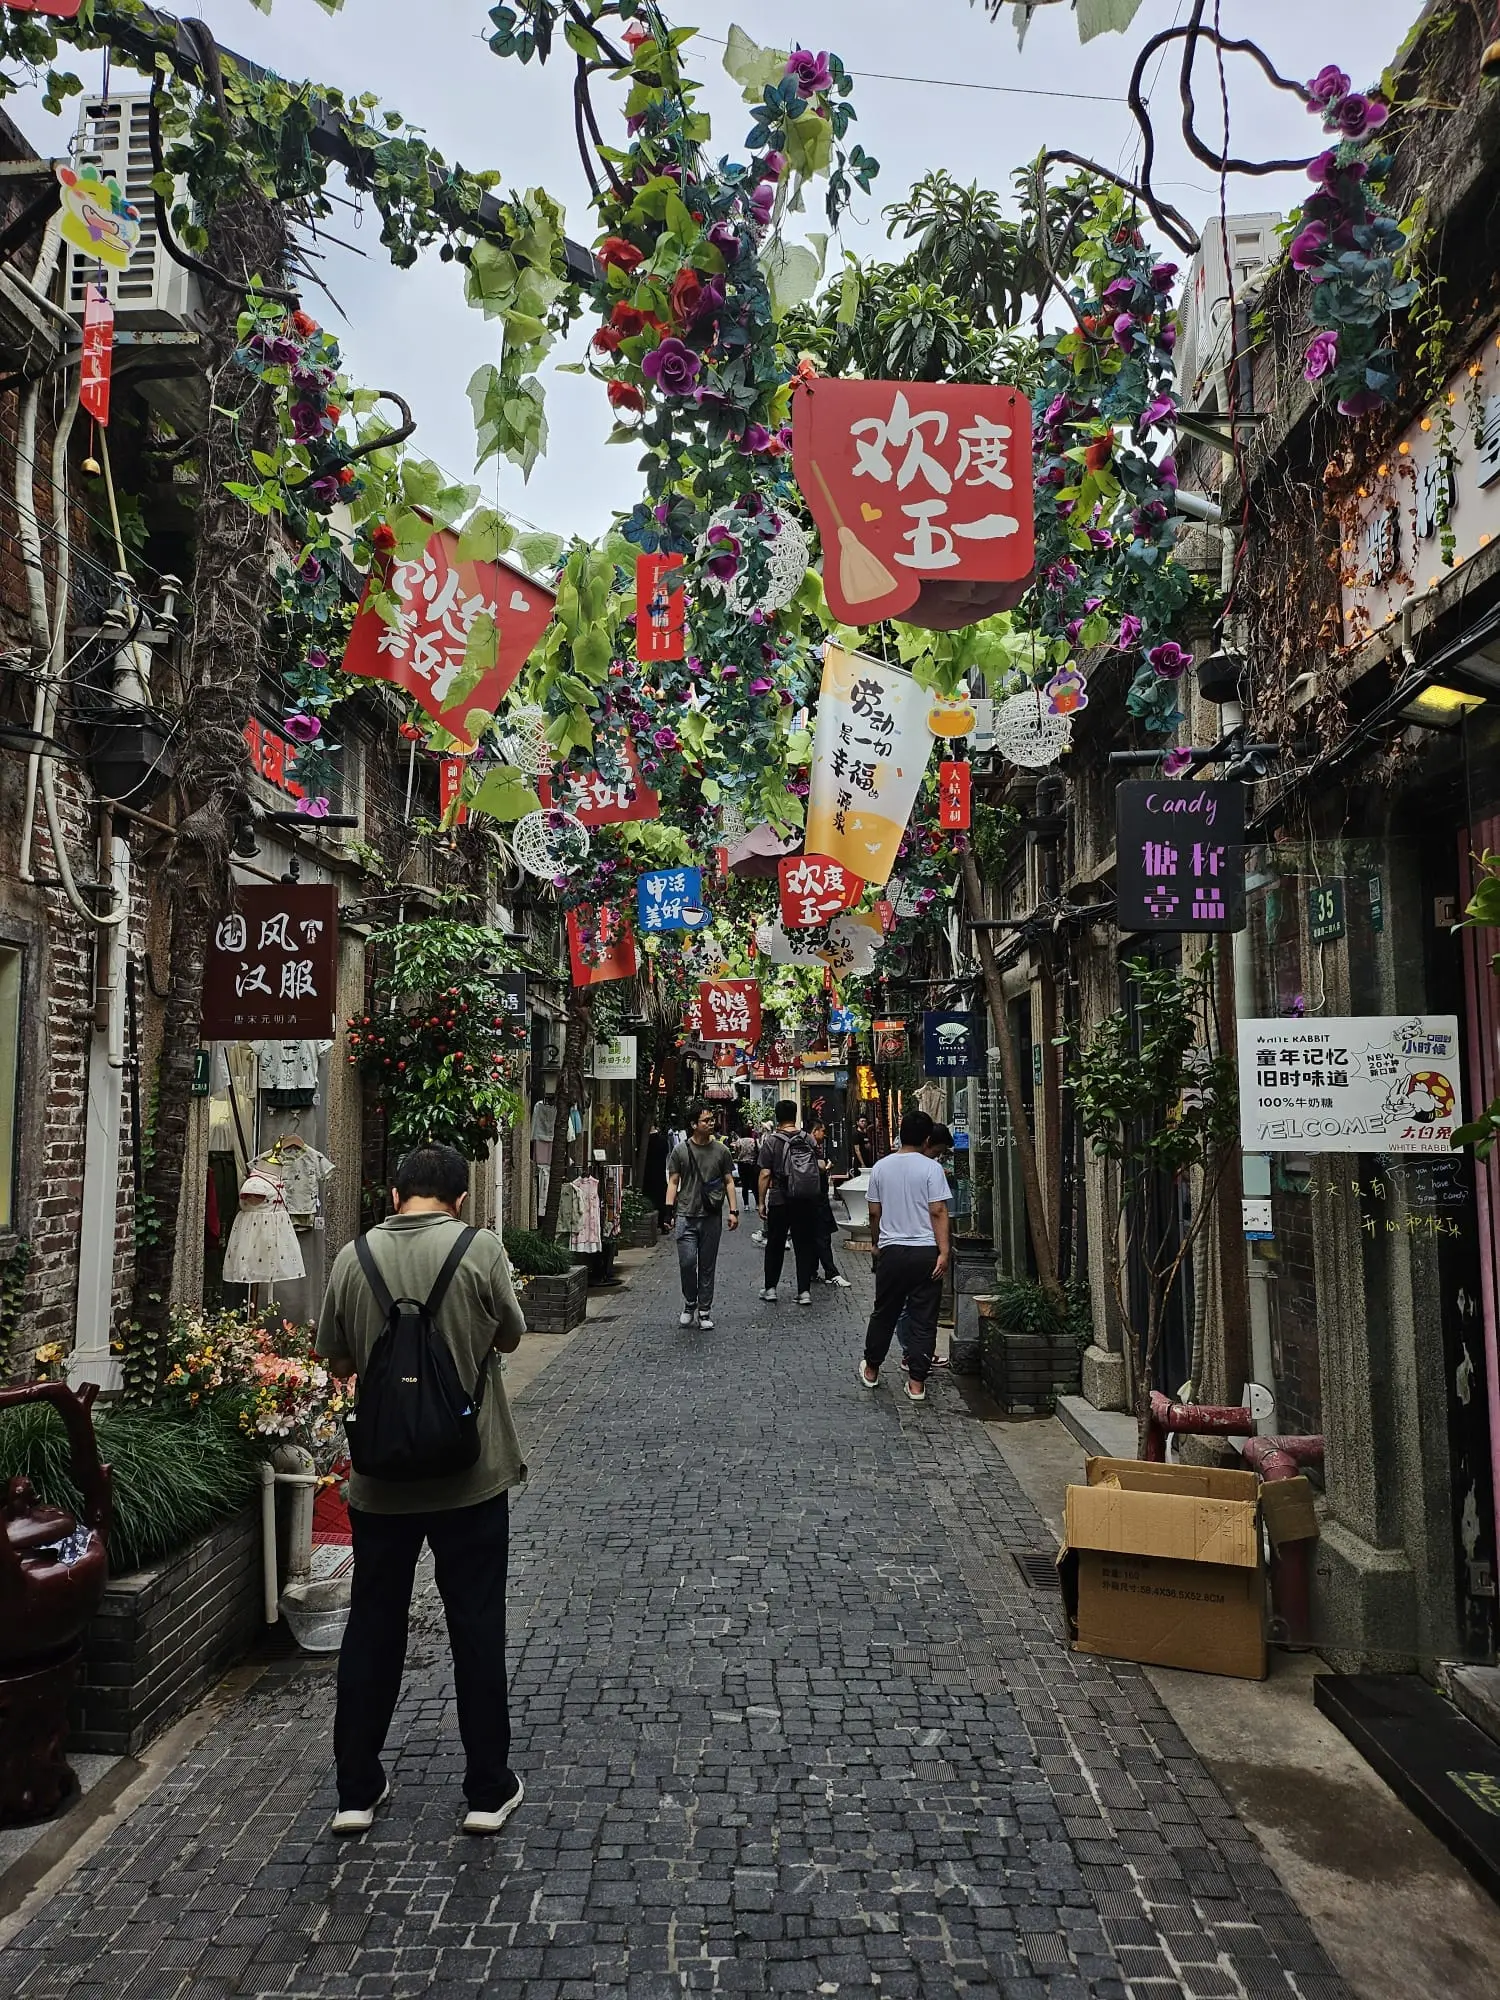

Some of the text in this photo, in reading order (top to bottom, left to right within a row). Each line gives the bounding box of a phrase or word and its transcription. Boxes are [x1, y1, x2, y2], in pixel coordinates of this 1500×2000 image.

[850, 390, 1013, 495] 欢度
[893, 498, 1020, 570] 五一
[850, 678, 894, 736] 劳动
[839, 722, 893, 758] 是一切
[830, 747, 879, 800] 幸福的
[832, 787, 853, 836] 源泉
[1146, 790, 1217, 826] Candy
[646, 872, 685, 903] 申活
[786, 860, 845, 896] 欢度
[645, 897, 682, 929] 美好
[798, 897, 842, 924] 五一
[1318, 889, 1334, 922] 35
[215, 912, 299, 953] 国风
[236, 959, 318, 1001] 汉服
[234, 1014, 297, 1025] 唐宋元明清
[714, 1008, 751, 1032] 美好
[936, 1055, 969, 1066] 京扇子
[1256, 1048, 1349, 1066] 童年记忆
[1367, 1053, 1394, 1061] NEW
[1402, 1040, 1447, 1055] 小时候
[1369, 1059, 1399, 1069] 20+种
[1370, 1067, 1397, 1077] 新口味
[1257, 1070, 1349, 1087] 旧时味道
[1258, 1097, 1333, 1108] 100%牛奶糖
[1400, 1126, 1452, 1140] 大白兔
[1389, 1144, 1417, 1152] WHITE
[1302, 1176, 1386, 1200] 今天只有
[1361, 1213, 1462, 1239] 开心和快乐
